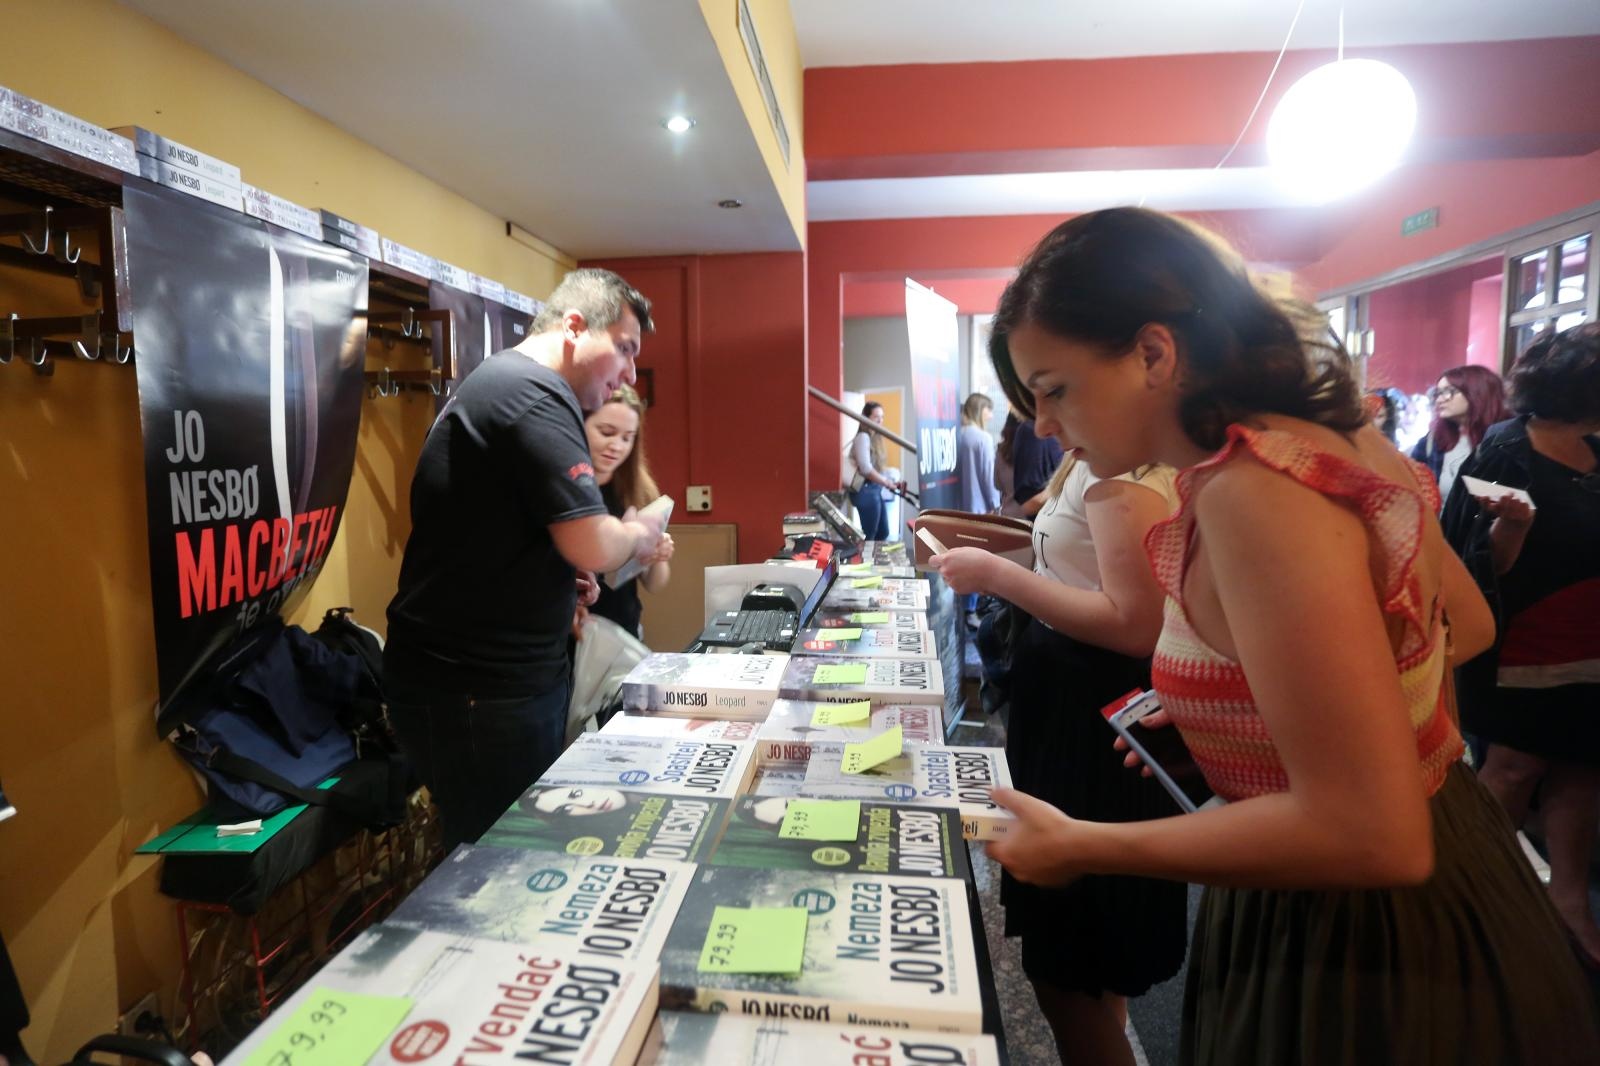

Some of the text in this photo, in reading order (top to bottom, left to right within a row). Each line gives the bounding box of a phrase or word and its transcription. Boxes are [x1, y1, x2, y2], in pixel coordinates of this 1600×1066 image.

[165, 410, 206, 464] JO
[920, 427, 932, 475] JO
[169, 465, 260, 525] NESBØ
[175, 505, 338, 620] MACBETH
[663, 691, 676, 706] JO
[676, 691, 708, 708] NESBØ
[715, 695, 746, 709] Leopard
[684, 743, 738, 793] JO NESBØ
[767, 743, 812, 761] JO NESB
[921, 750, 954, 798] Spasitelj
[952, 751, 992, 790] NESBØ
[789, 810, 808, 836] 79,99
[958, 790, 996, 809] JO
[896, 810, 943, 854] NESBØ
[899, 853, 944, 876] JO
[540, 864, 618, 935] Nemeza
[592, 866, 667, 933] NESBØ
[836, 882, 882, 961] Nemeza
[888, 884, 943, 956] NESBØ
[709, 923, 738, 965] 79,99
[889, 958, 945, 994] JO
[514, 965, 620, 1066] NESBØ
